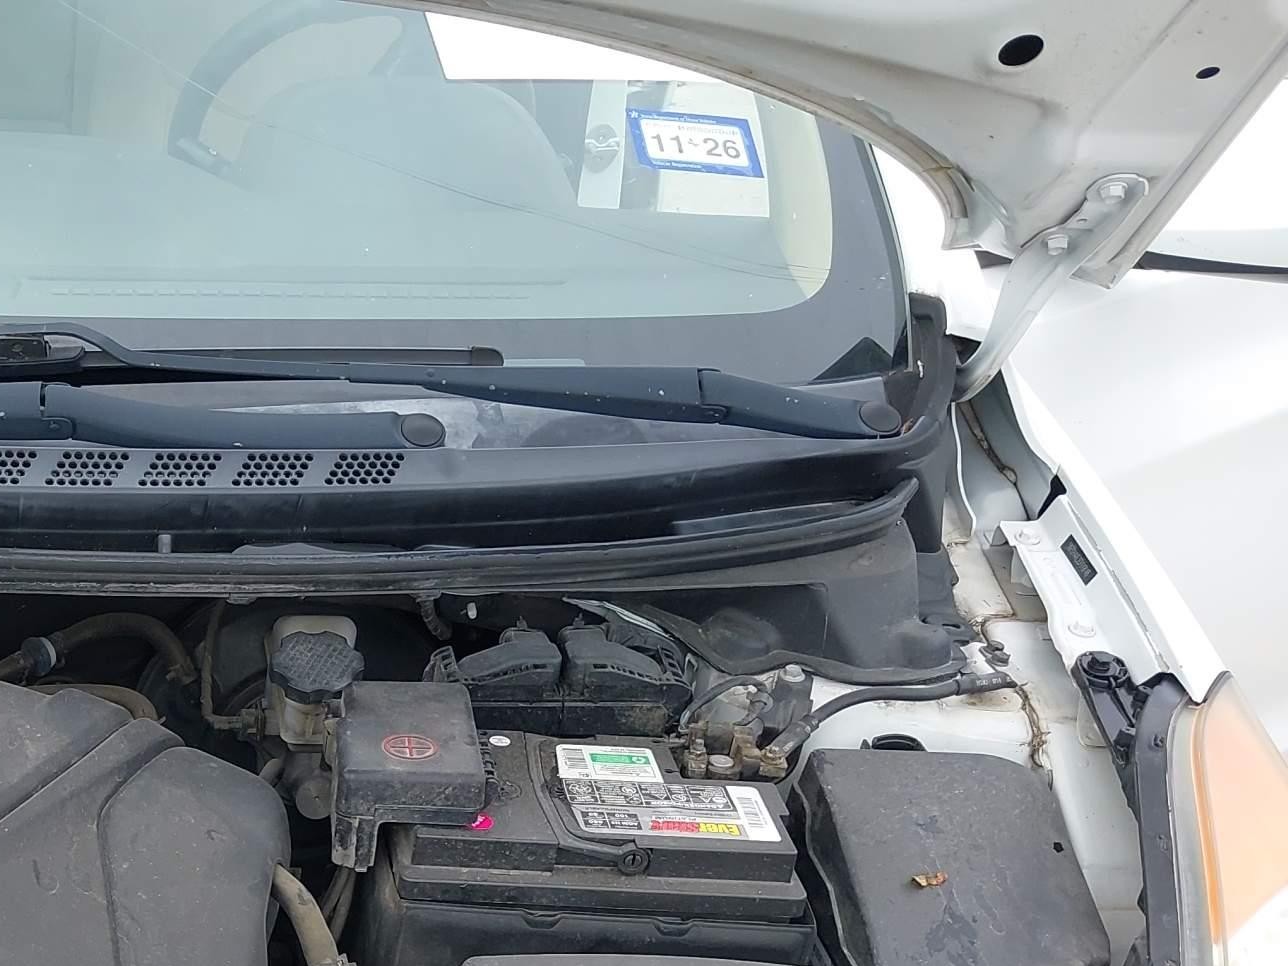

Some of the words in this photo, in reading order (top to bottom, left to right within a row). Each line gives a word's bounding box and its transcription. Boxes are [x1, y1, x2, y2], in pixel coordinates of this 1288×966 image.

[651, 133, 684, 154] 11
[703, 138, 741, 159] 26
[650, 819, 741, 837] EverStart
